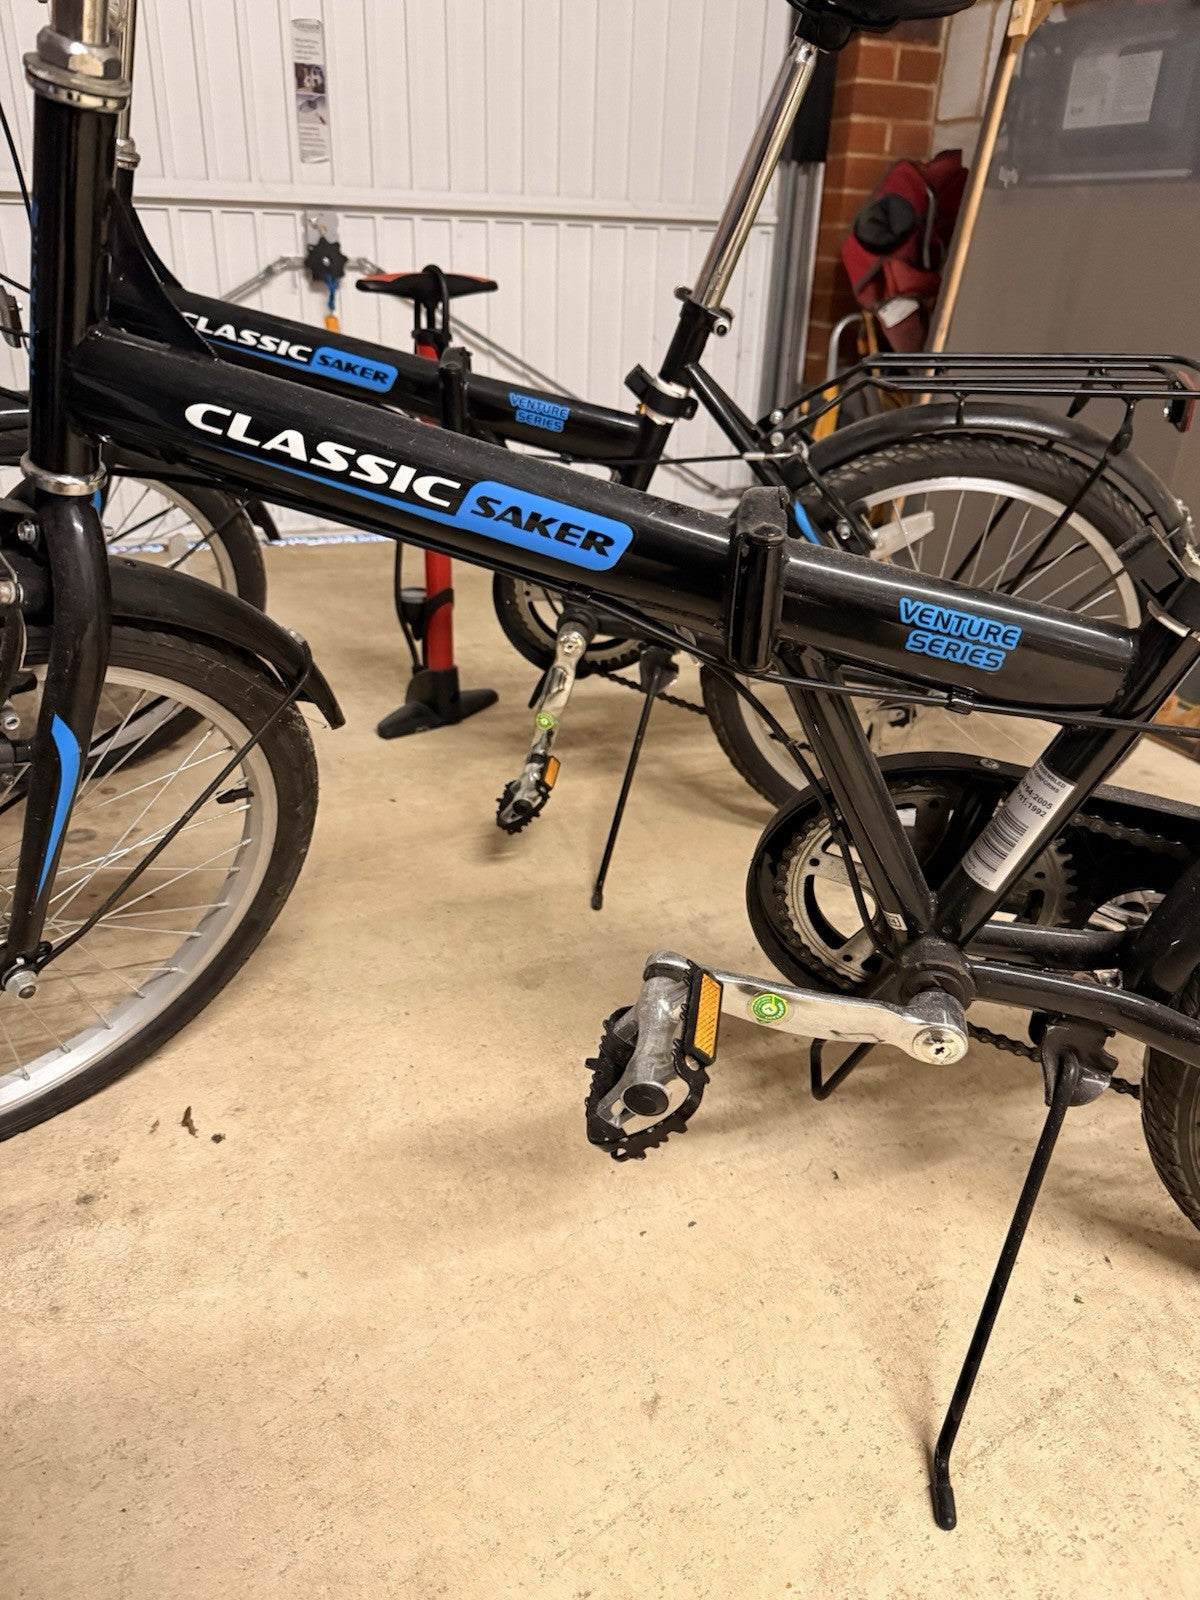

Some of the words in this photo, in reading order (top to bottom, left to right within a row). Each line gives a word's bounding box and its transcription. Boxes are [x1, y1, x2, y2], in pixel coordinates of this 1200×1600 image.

[317, 353, 389, 385] SAKER
[510, 393, 569, 419] VENTURE
[517, 411, 563, 431] SERIES
[184, 403, 461, 508] CLASSIC
[471, 495, 616, 557] SAKER
[902, 599, 1020, 648] VENTURE
[907, 631, 1004, 669] SERIES
